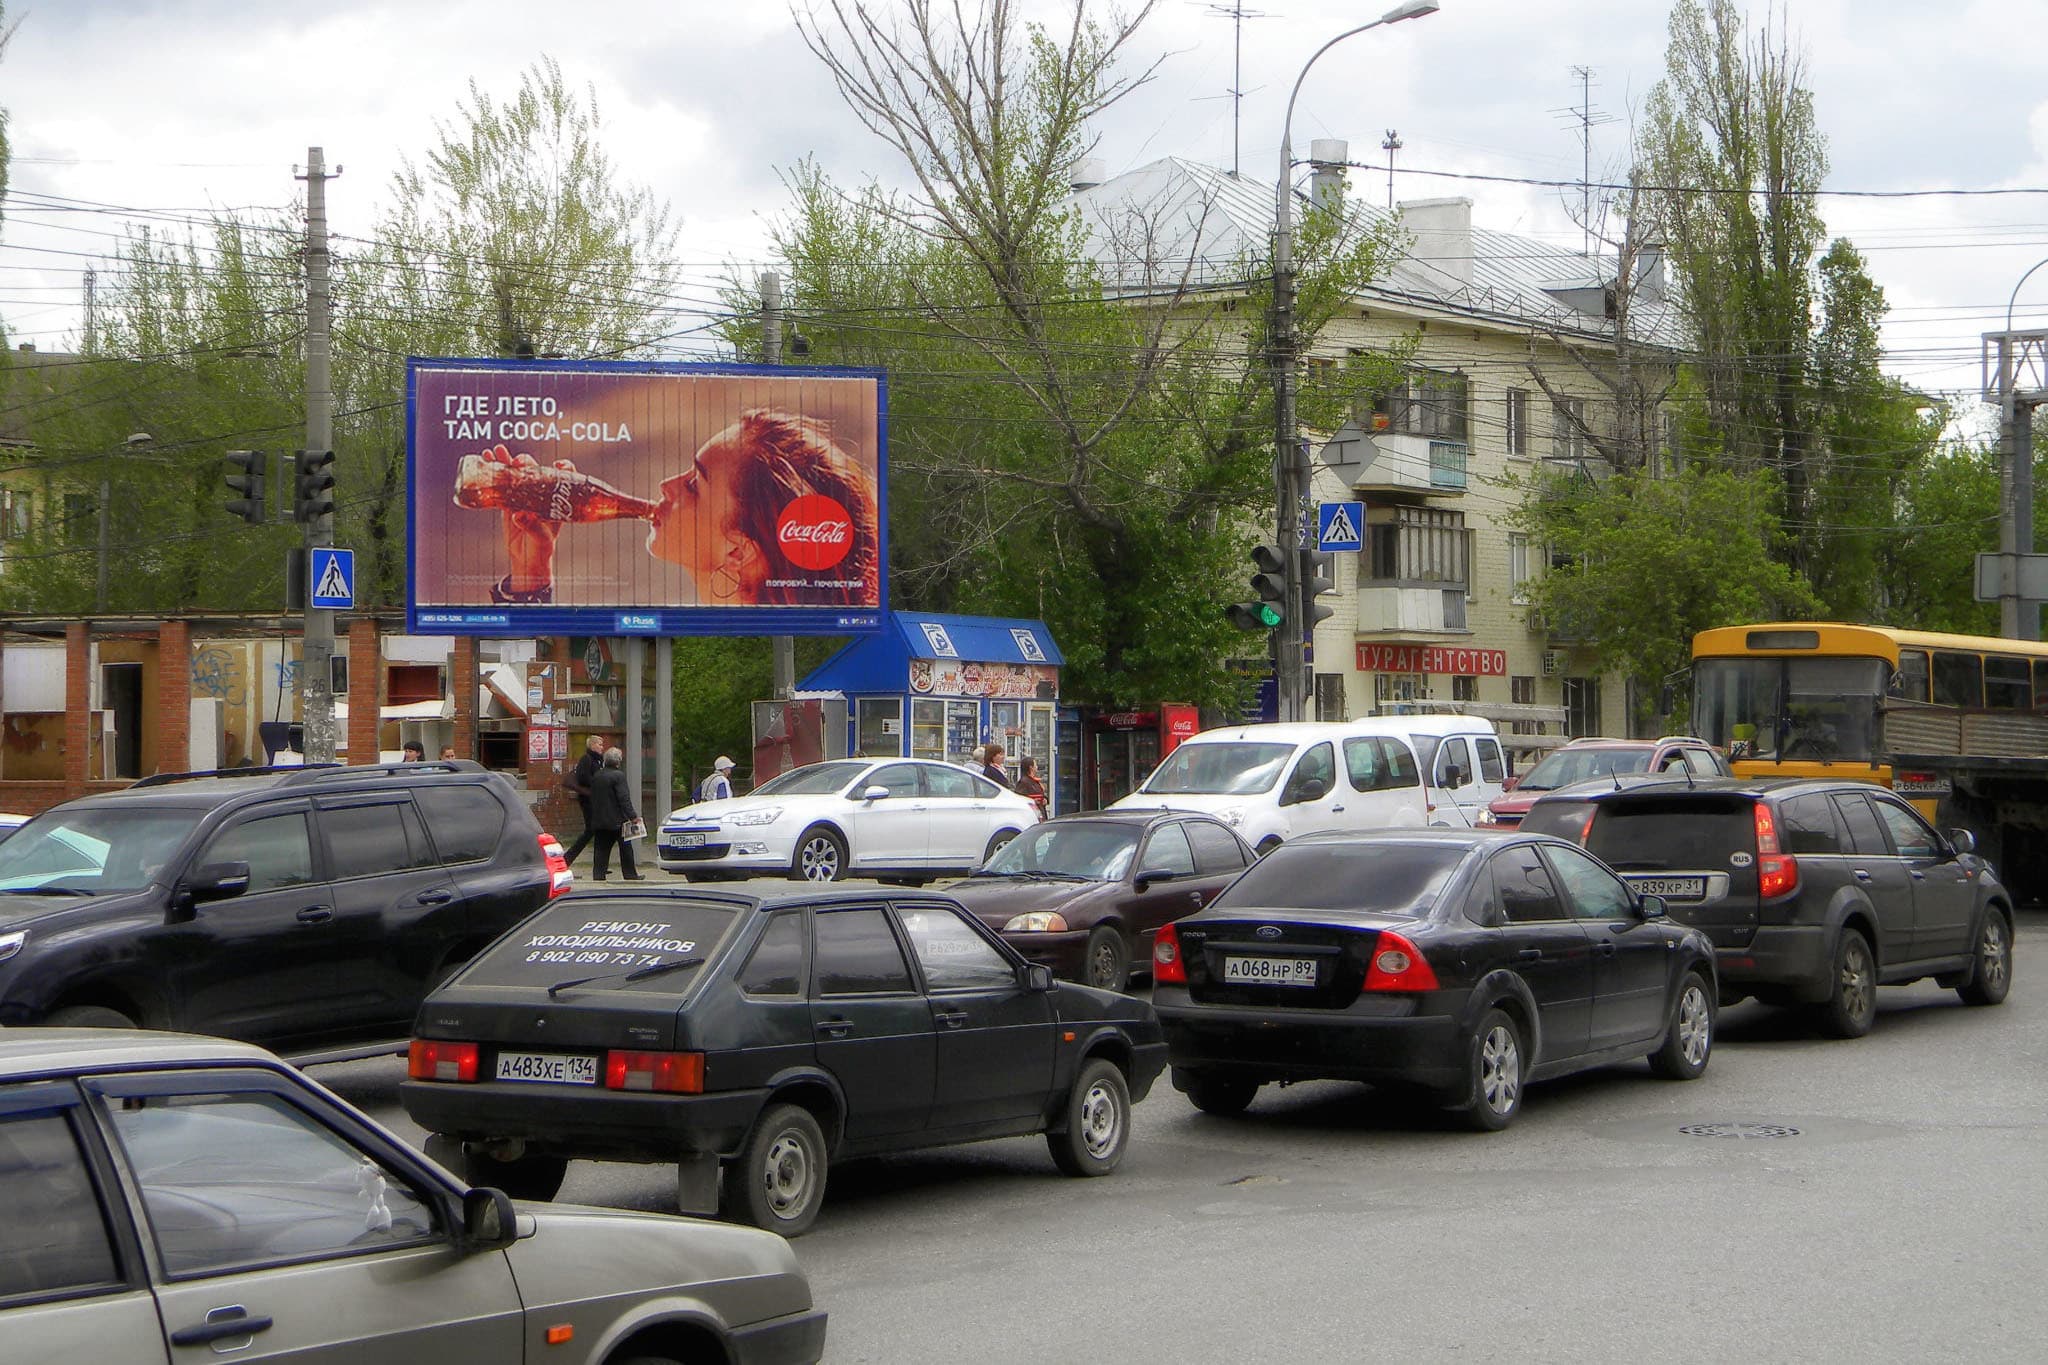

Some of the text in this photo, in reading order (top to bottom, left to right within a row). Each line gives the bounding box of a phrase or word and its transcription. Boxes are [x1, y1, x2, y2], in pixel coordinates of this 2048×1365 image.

[444, 396, 564, 419] ГДЕ ЛЕТО,
[444, 420, 632, 442] ТАМ COCA-COLA
[780, 519, 849, 543] Coca-Cola
[1359, 646, 1504, 674] ТУРАГЕНТСТВО
[1733, 855, 1749, 864] RUS
[1686, 879, 1699, 891] 31
[579, 921, 672, 935] РЕМОНТ
[524, 935, 696, 954] ХОЛОДИЛЬНИКОВ
[526, 951, 663, 966] 8 902 090 73 74
[1295, 961, 1311, 975] 89
[501, 1057, 592, 1079] А483ХЕ 134
